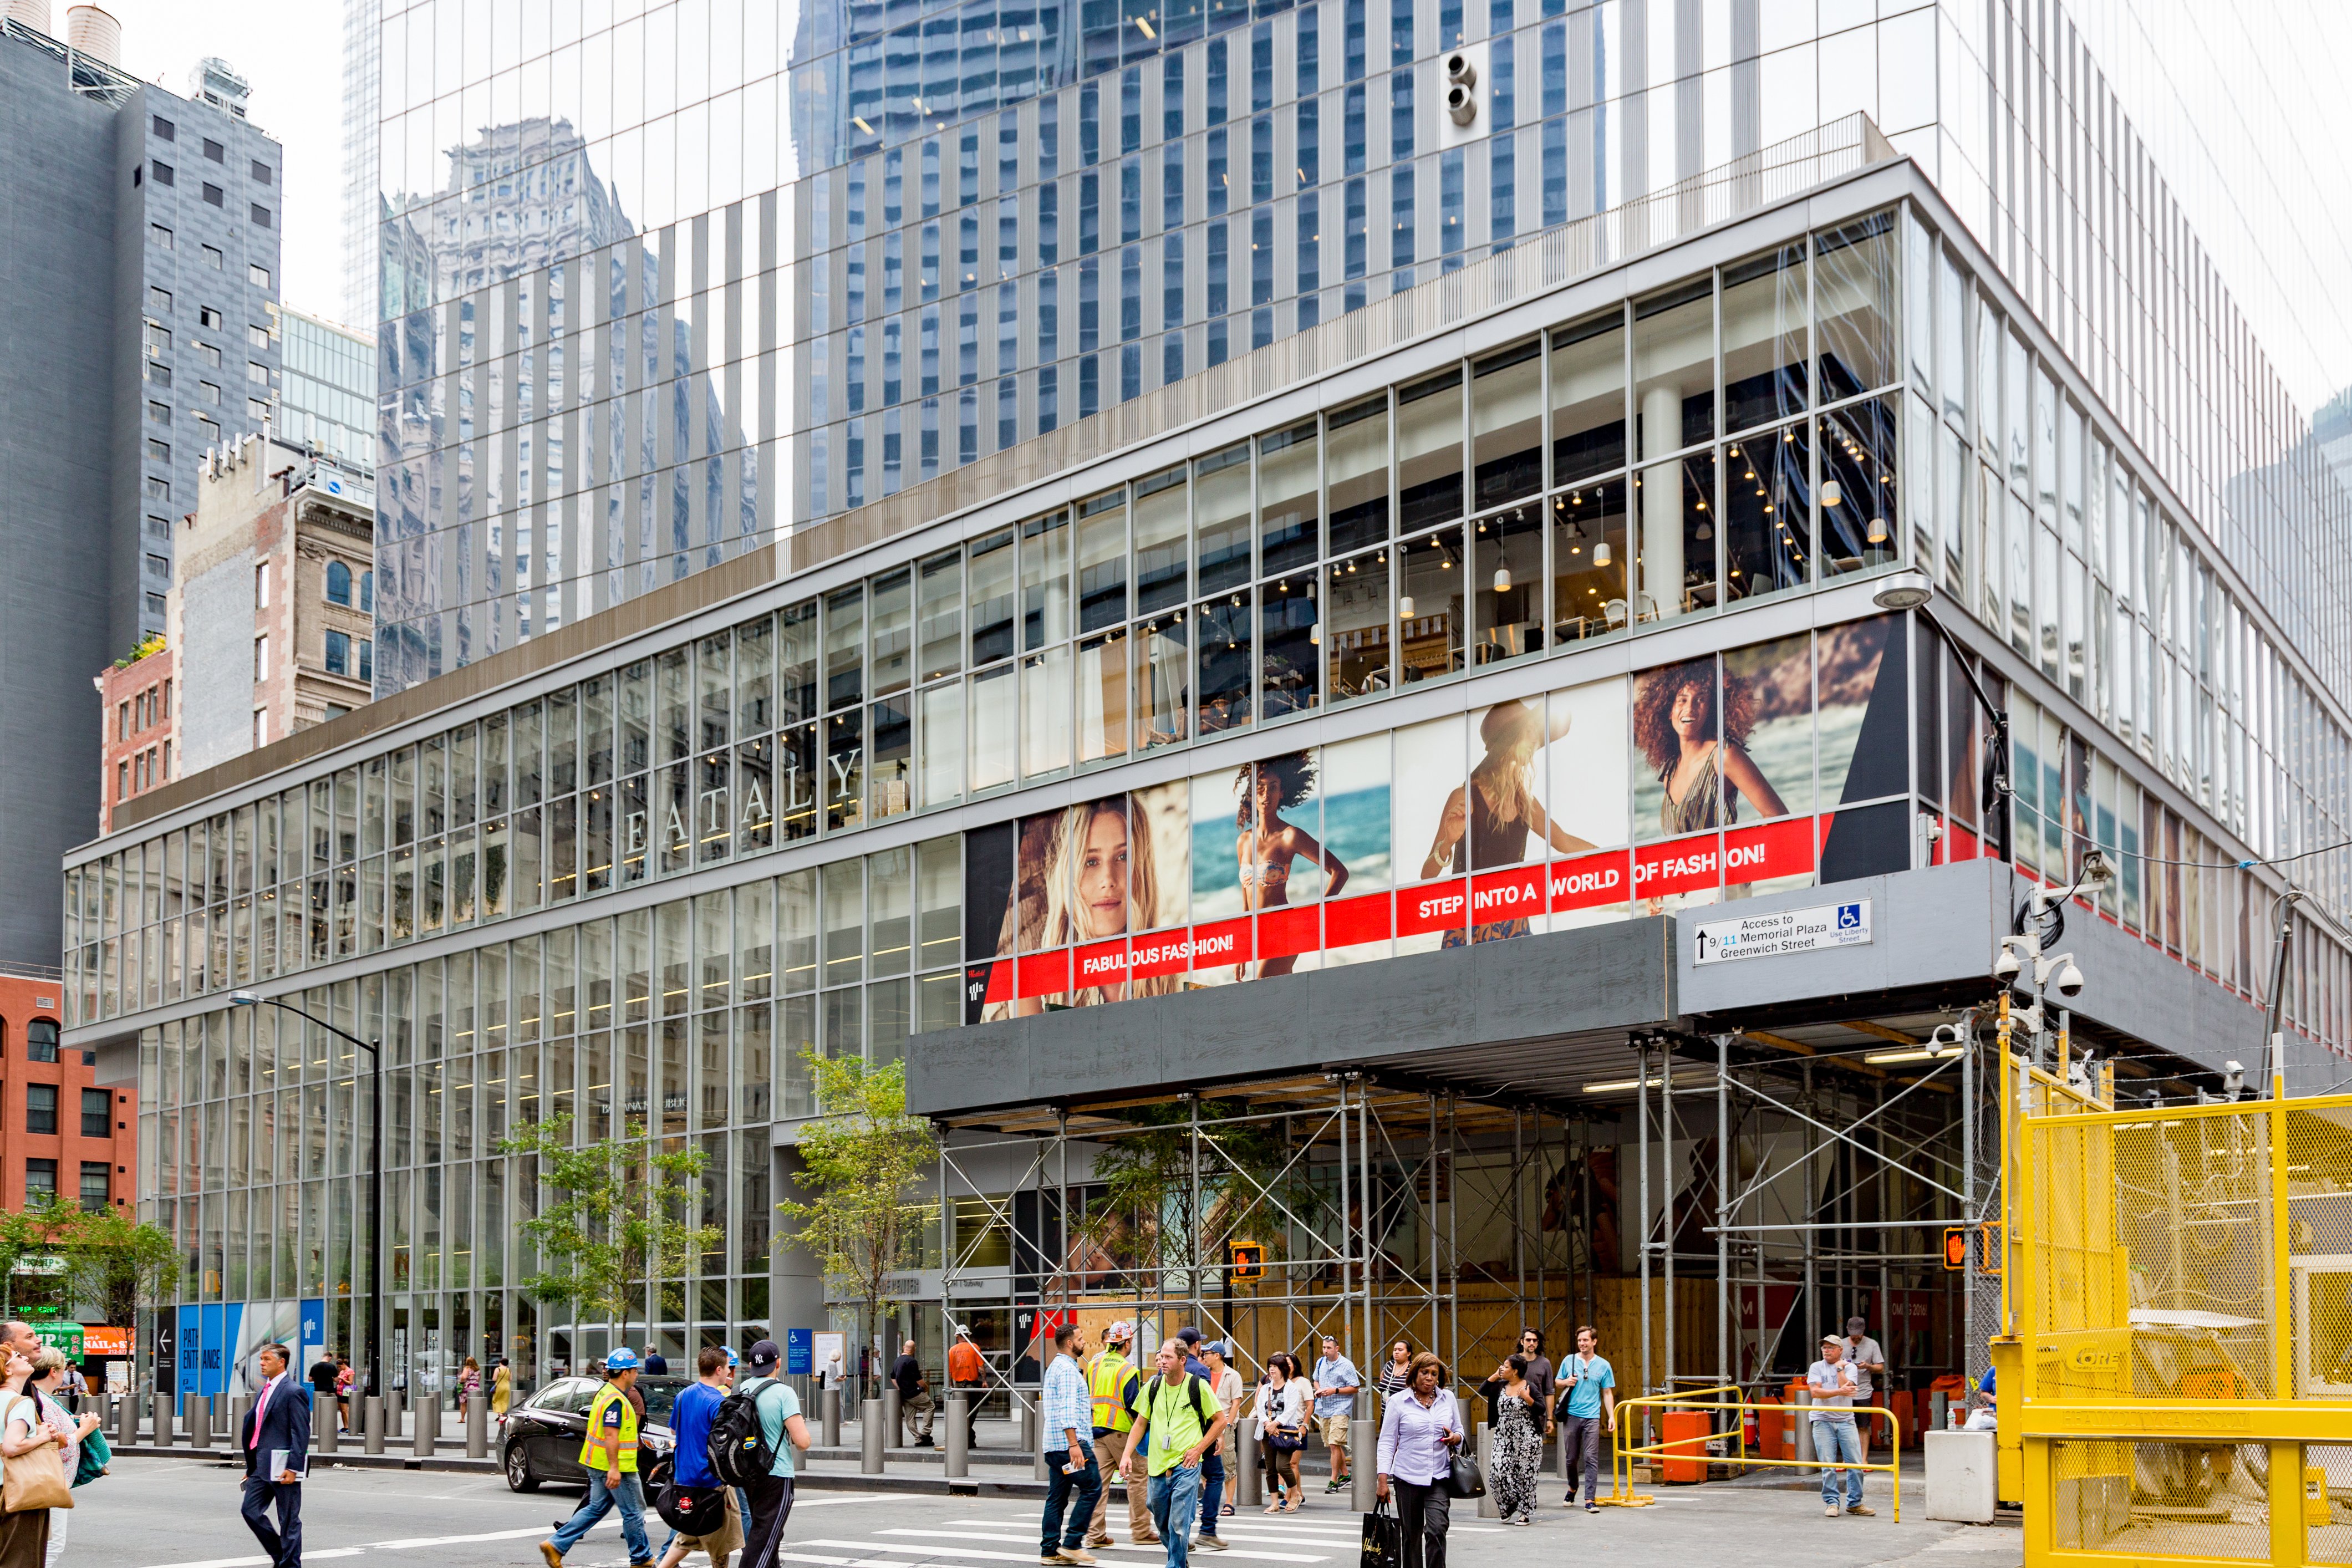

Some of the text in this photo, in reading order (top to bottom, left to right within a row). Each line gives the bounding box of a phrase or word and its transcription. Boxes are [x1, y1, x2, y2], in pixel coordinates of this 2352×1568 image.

[625, 747, 862, 854] EATALY
[1419, 843, 1765, 918] STEP INTO A WORLD OF FASHION!
[1741, 915, 1793, 930] Access to
[1845, 927, 1869, 936] Liberty
[1709, 923, 1827, 949] 9/11 Memorial Plaza
[1839, 935, 1860, 944] Street
[1083, 934, 1233, 974] FABULOUS FASHION!
[1720, 937, 1815, 958] Greenwich Street
[84, 1340, 112, 1349] NAIL
[605, 1411, 618, 1419] 34
